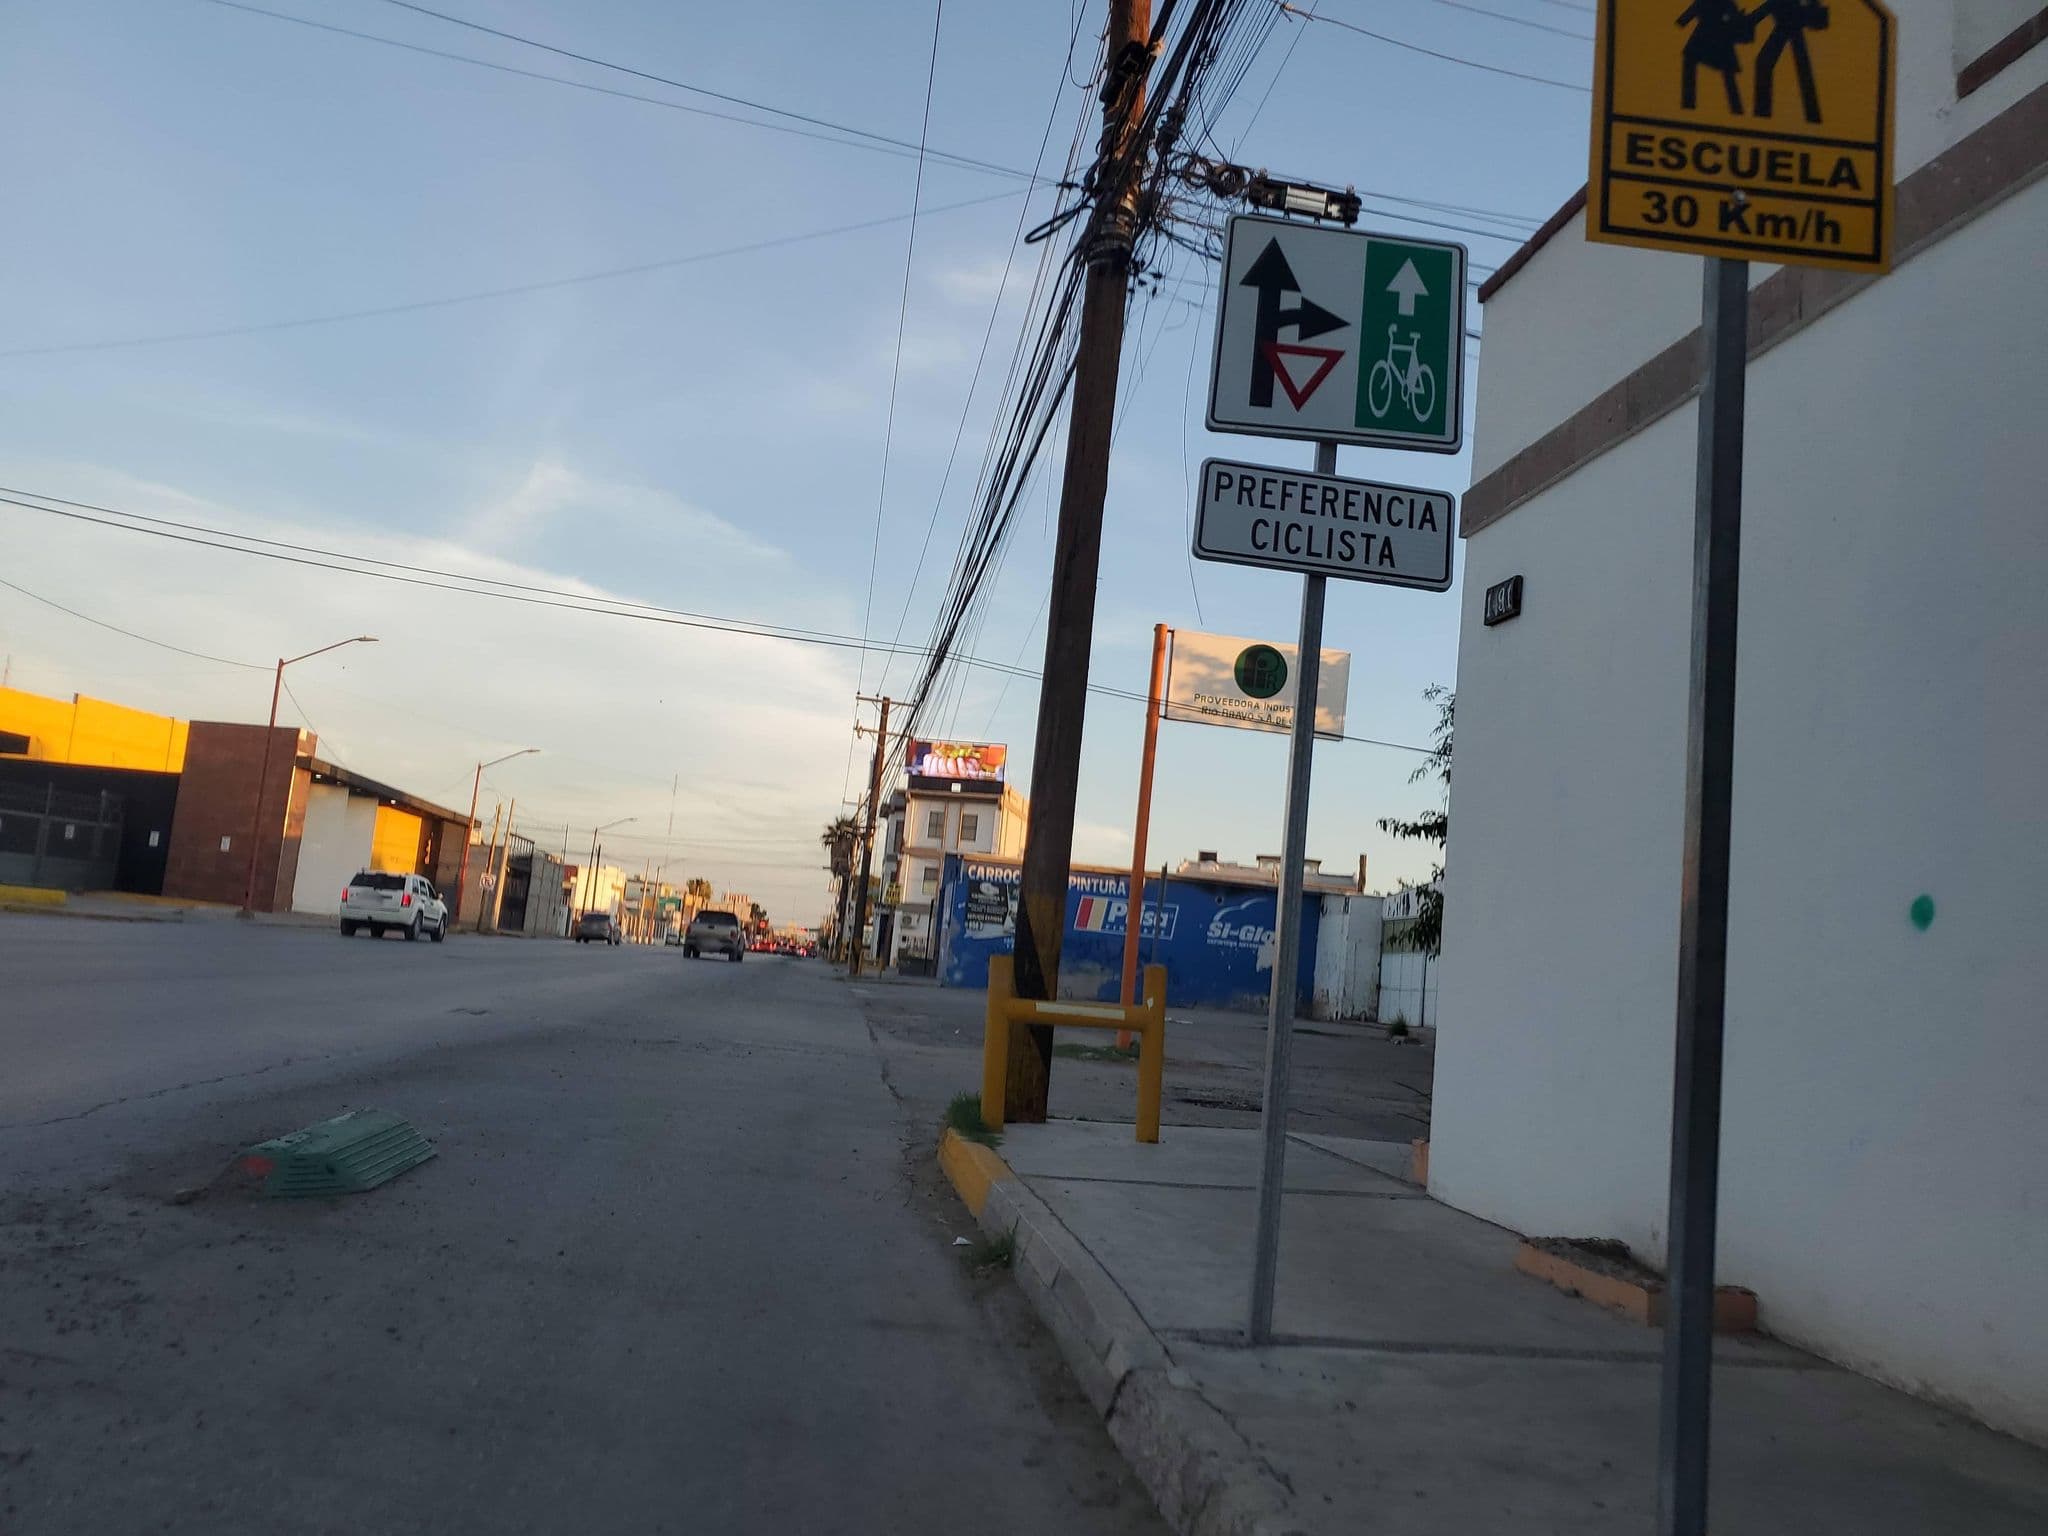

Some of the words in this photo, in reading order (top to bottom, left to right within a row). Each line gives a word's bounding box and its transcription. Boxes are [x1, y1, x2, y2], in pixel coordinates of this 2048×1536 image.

[1626, 132, 1861, 190] ESCUELA
[1641, 190, 1698, 228] 30
[1718, 199, 1841, 244] Km/h
[1214, 471, 1437, 532] PREFERENCIA
[1251, 518, 1395, 568] CICLISTA
[1194, 693, 1260, 710] PROVEEDORA
[968, 864, 1021, 885] CARROC
[1068, 875, 1126, 895] PINTURA
